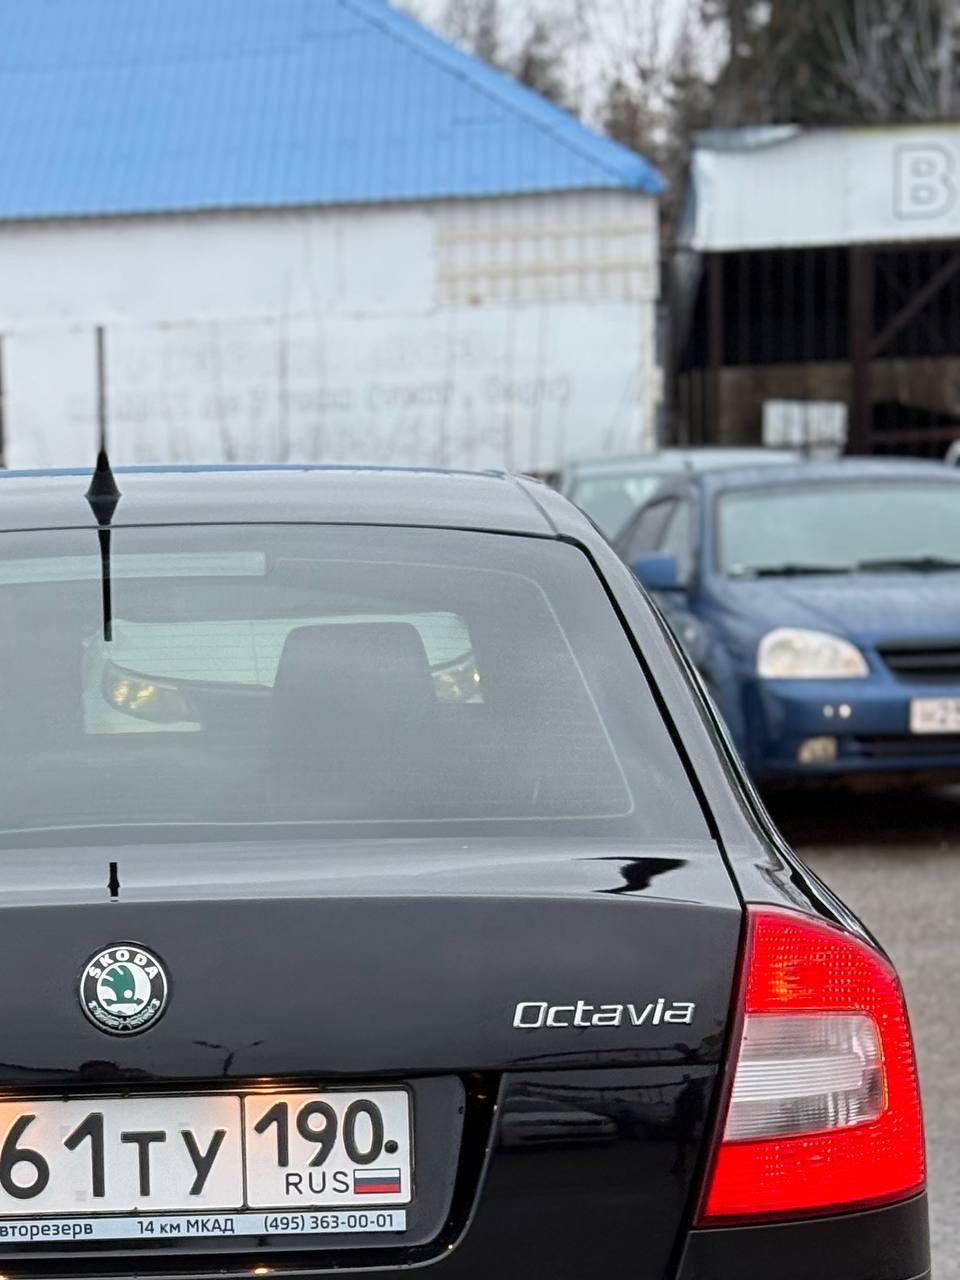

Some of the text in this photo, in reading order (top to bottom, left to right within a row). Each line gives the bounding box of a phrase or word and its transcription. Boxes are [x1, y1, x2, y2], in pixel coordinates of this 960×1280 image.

[513, 998, 696, 1028] Octavia
[254, 1099, 384, 1168] 190
[285, 1170, 350, 1196] RUS
[137, 1218, 235, 1234] 14 км МКАД
[264, 1214, 394, 1232] (495) 363-00-01
